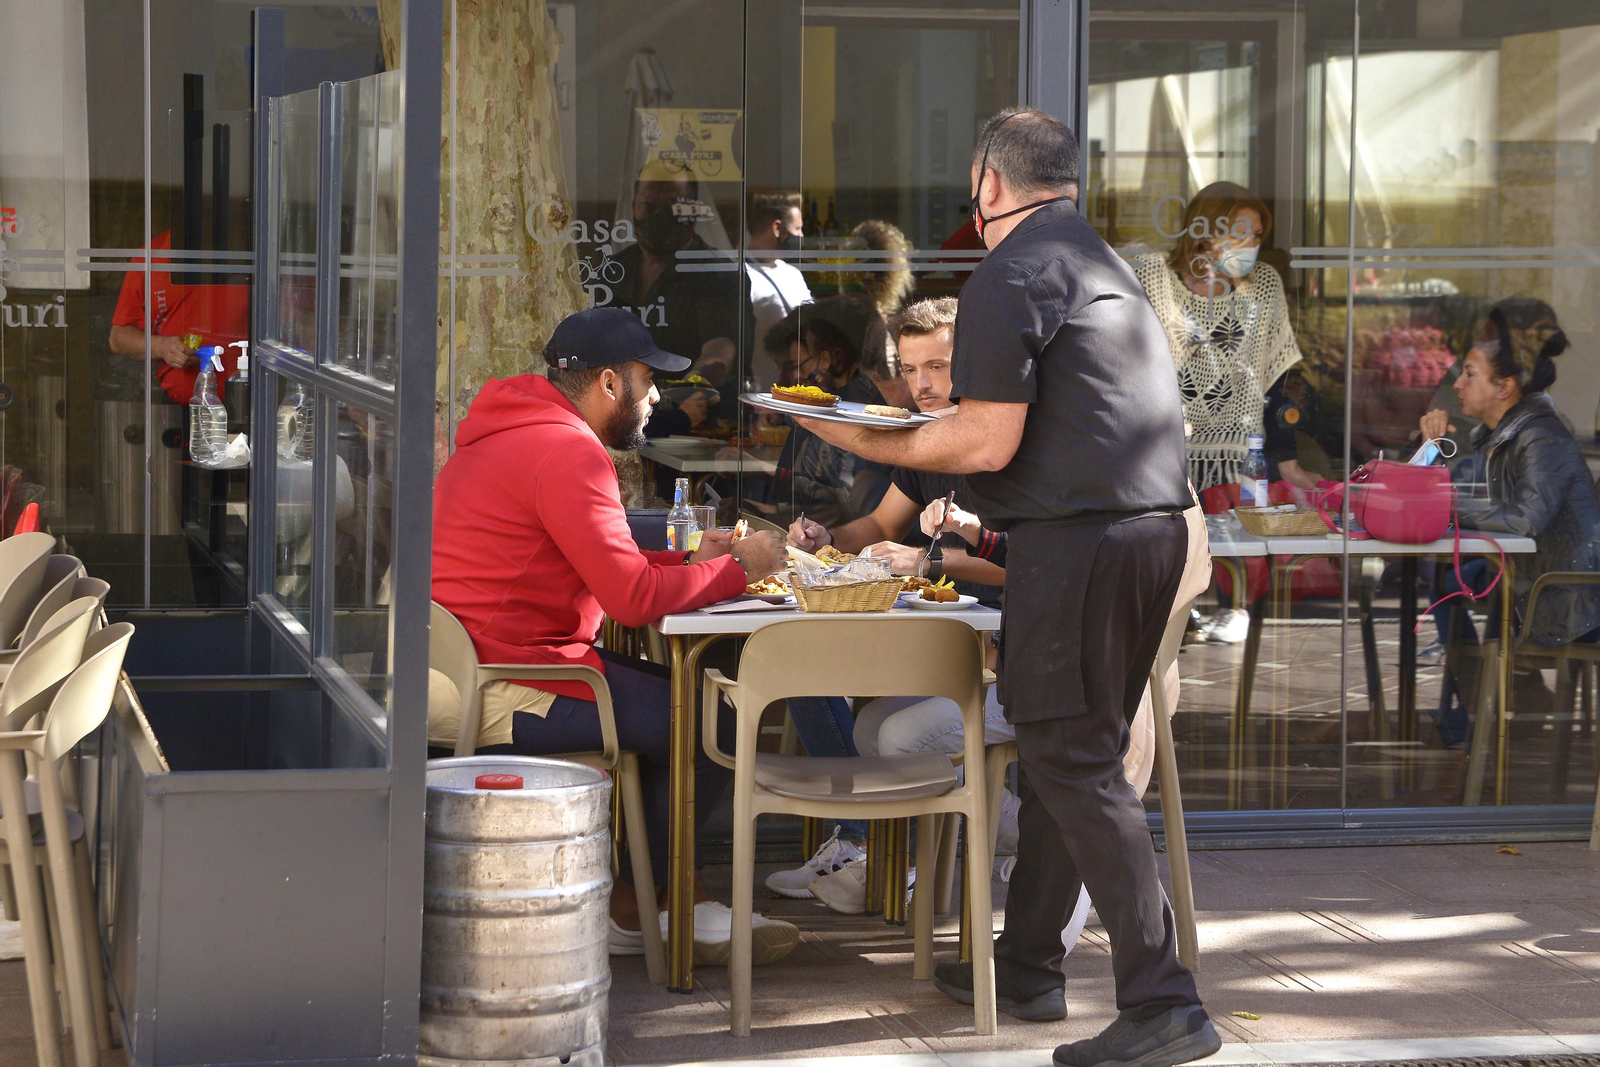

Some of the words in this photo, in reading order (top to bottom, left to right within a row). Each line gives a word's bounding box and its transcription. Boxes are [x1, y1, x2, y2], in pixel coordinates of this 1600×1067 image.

[525, 199, 637, 243] Casa
[1152, 196, 1255, 239] Casa
[0, 284, 68, 328] uri
[584, 284, 668, 328] Pri
